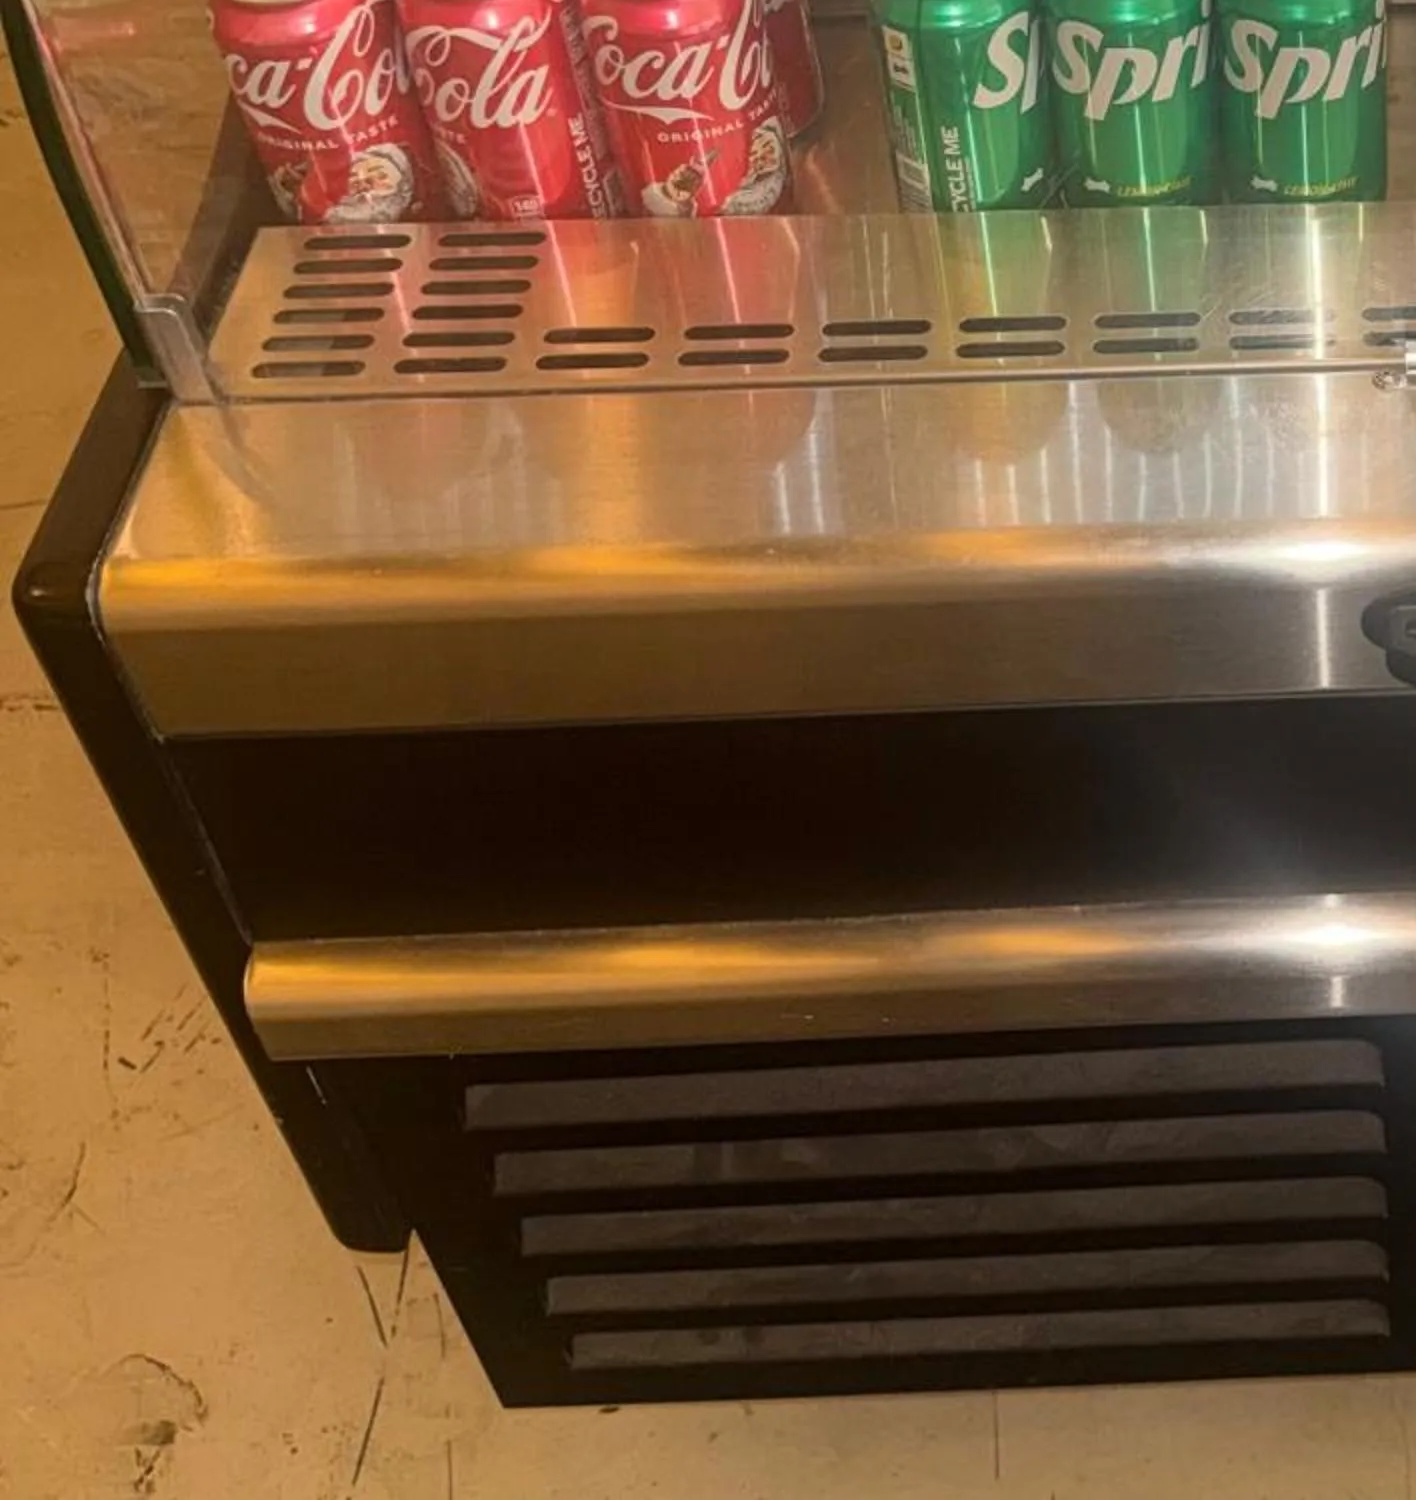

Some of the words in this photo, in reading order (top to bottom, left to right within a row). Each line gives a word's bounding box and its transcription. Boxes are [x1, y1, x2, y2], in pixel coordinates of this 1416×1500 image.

[568, 112, 588, 141] ME
[656, 119, 745, 143] ORIGINAL
[940, 125, 959, 149] ME
